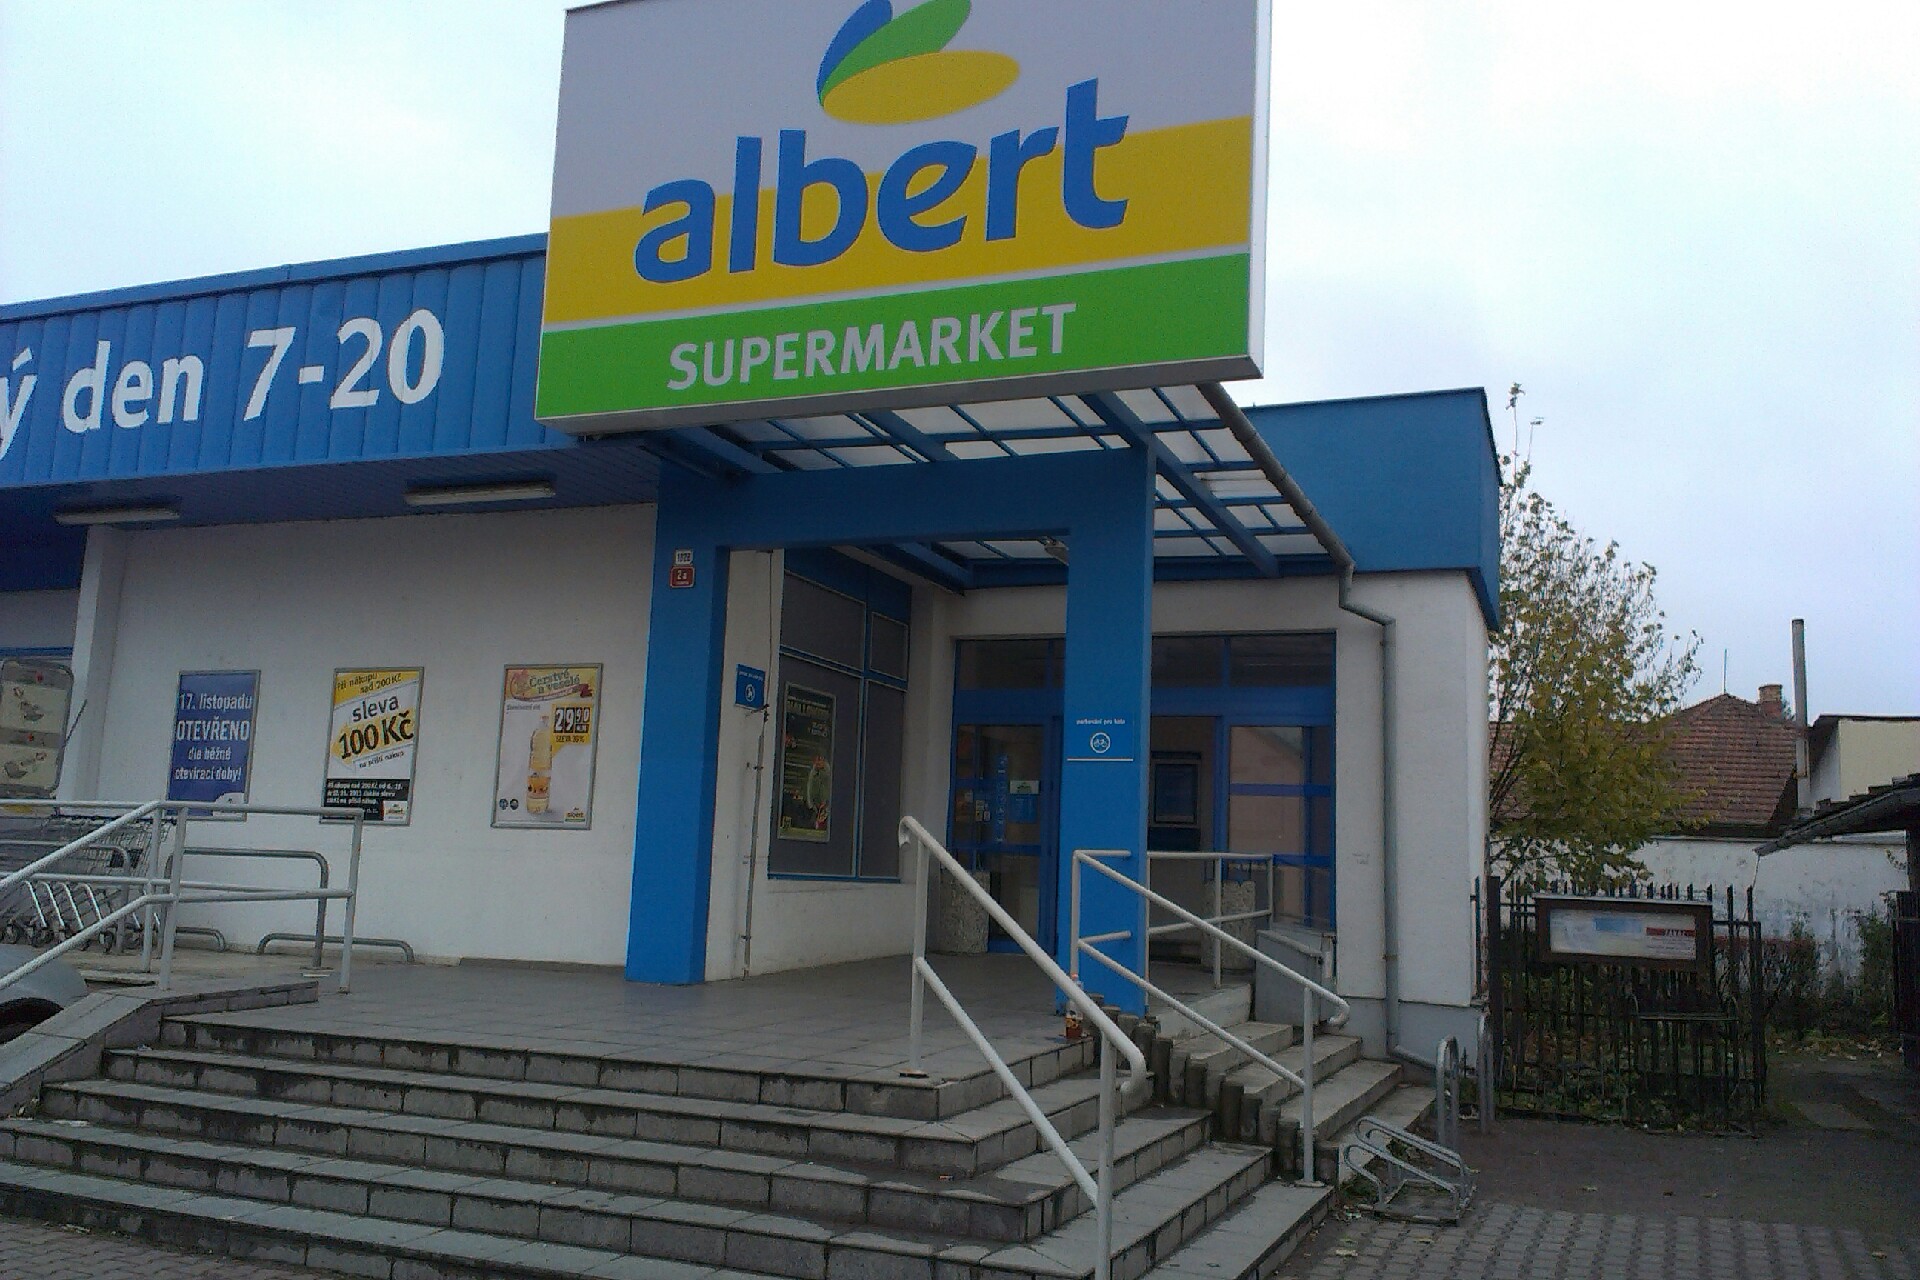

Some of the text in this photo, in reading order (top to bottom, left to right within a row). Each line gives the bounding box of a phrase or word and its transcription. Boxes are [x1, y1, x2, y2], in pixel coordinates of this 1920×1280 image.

[634, 77, 1130, 284] albert
[667, 302, 1077, 391] SUPERMARKET
[62, 340, 205, 434] den
[243, 308, 445, 421] 7-20
[179, 692, 253, 712] 17. listopadu
[352, 696, 400, 722] sleva
[176, 716, 250, 742] OTEVŘENO
[338, 710, 415, 760] 100 Kč
[188, 746, 232, 761] dle běžné
[215, 766, 242, 783] doby!
